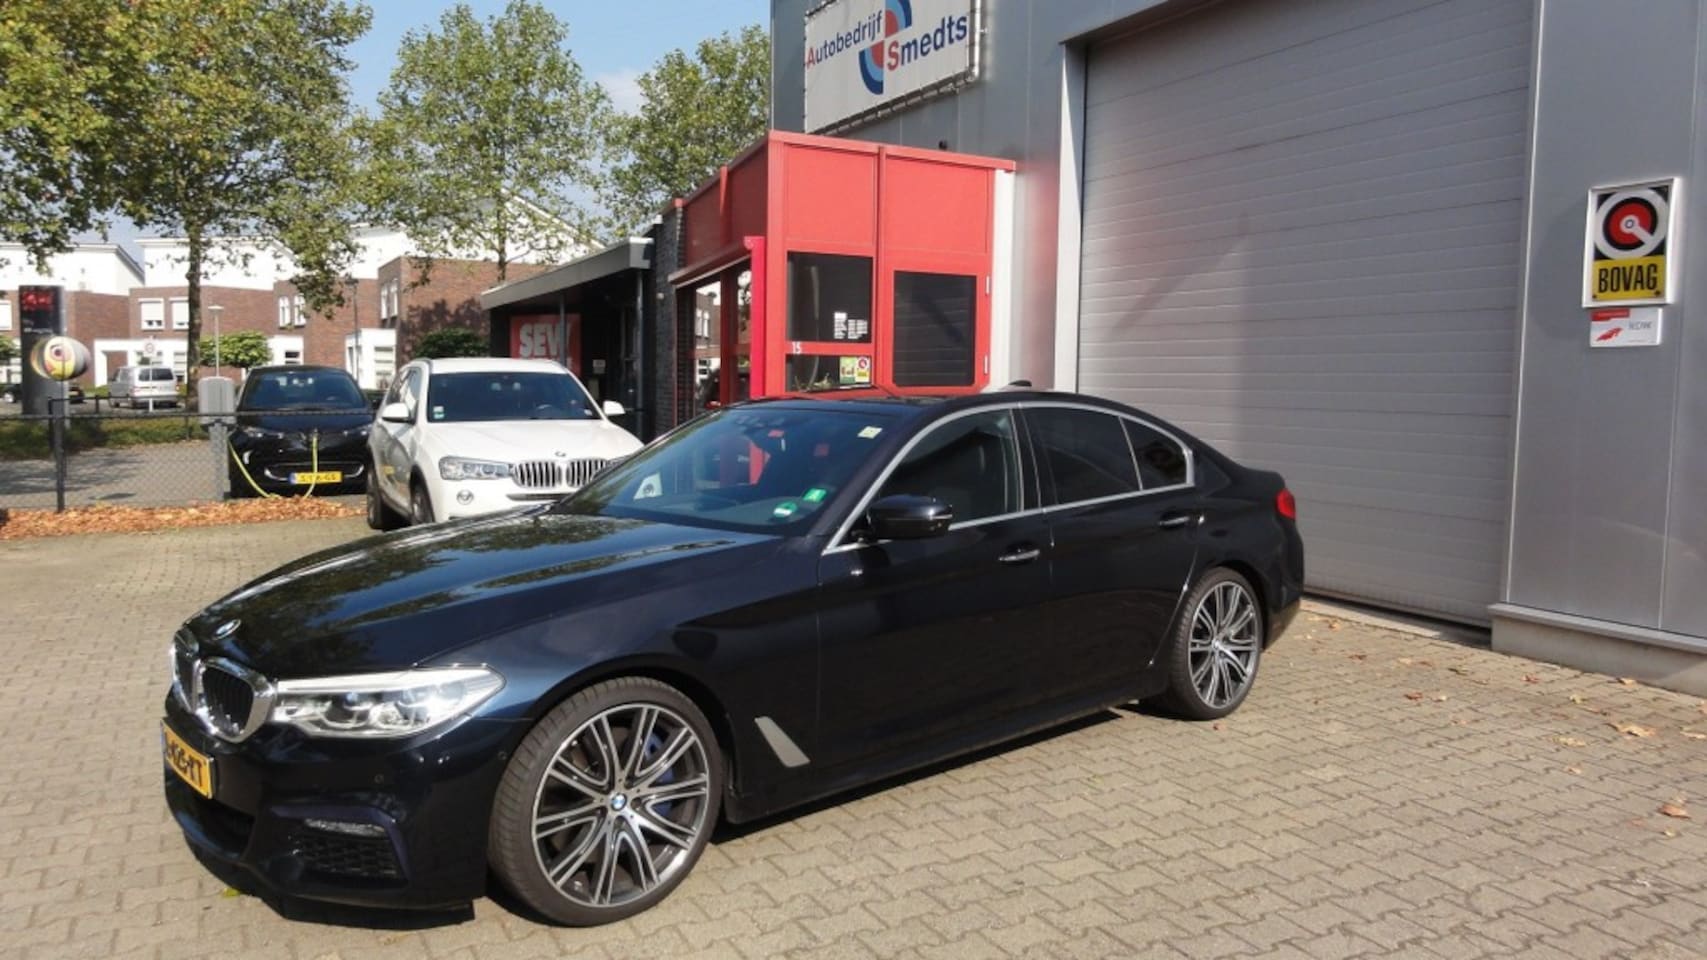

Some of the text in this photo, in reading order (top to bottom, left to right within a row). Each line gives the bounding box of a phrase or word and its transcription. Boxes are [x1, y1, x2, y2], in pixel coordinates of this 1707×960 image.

[807, 10, 883, 69] Autobedrijf
[886, 15, 968, 71] Smedts
[1598, 263, 1658, 293] BOVAG
